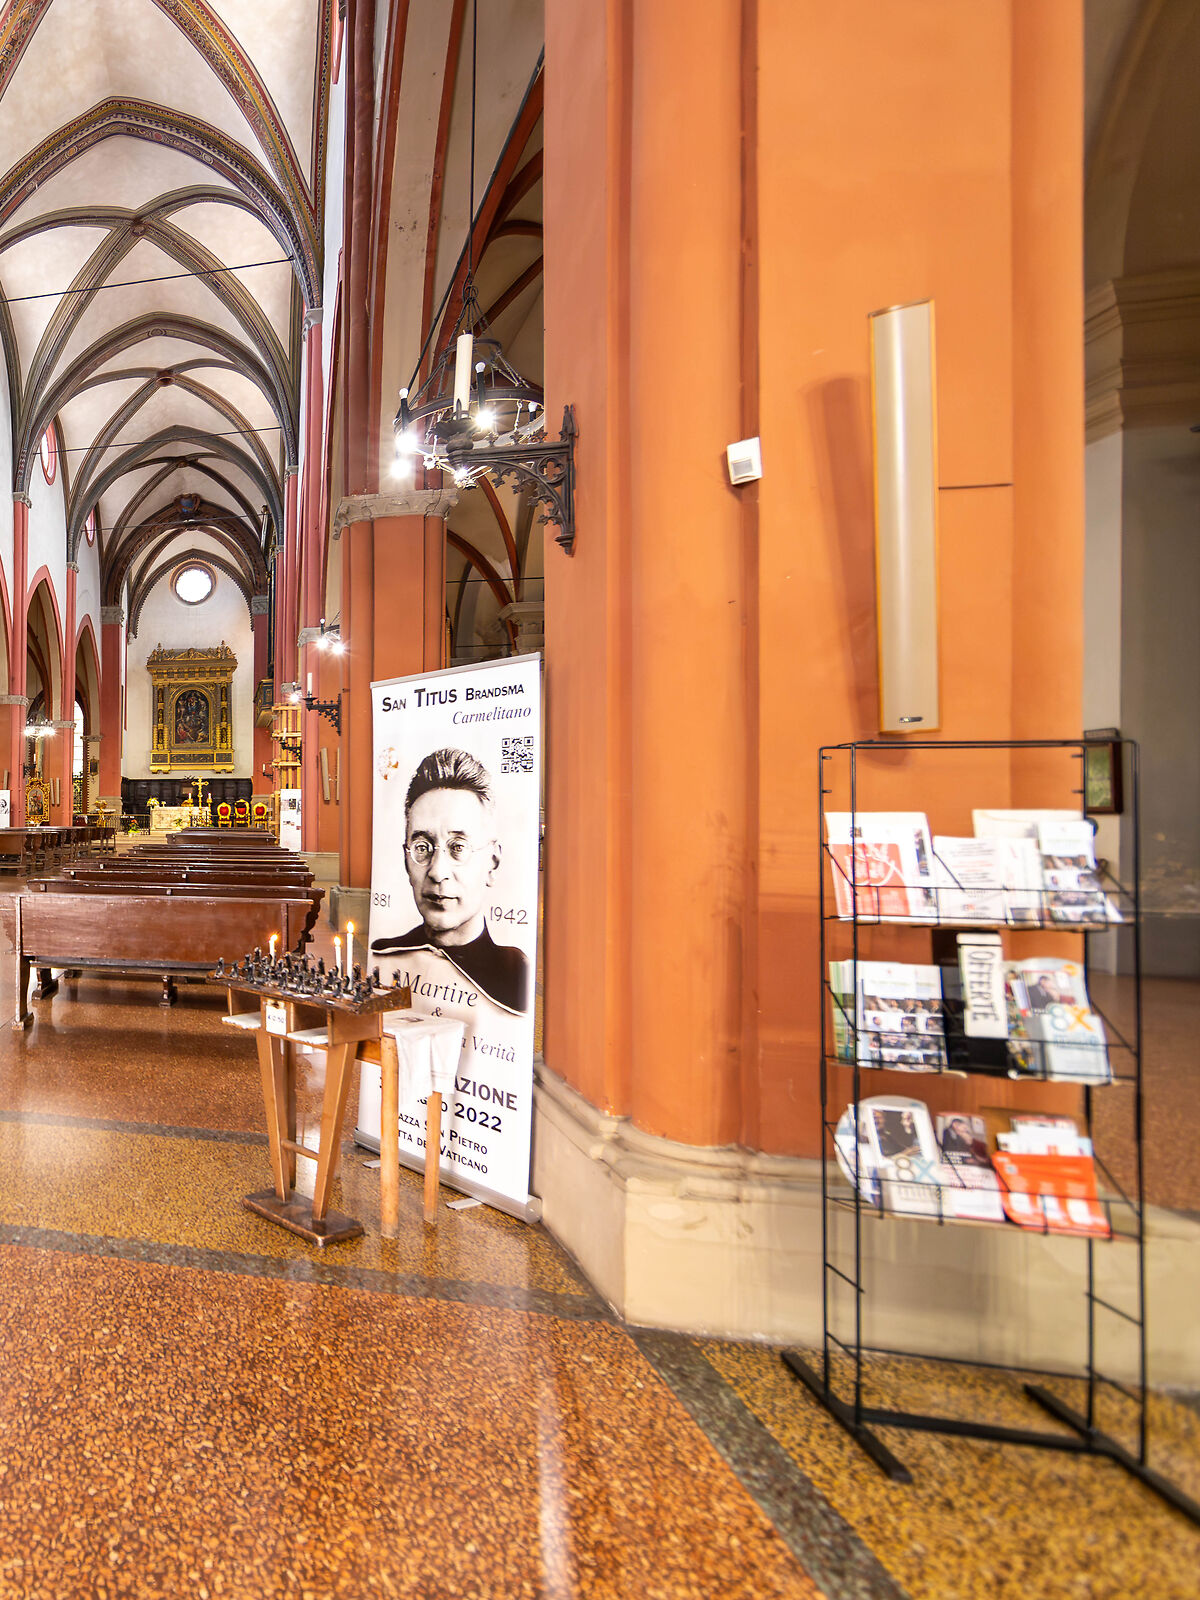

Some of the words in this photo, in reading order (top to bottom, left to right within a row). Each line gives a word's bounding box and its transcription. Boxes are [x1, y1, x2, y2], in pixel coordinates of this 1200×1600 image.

[452, 706, 532, 725] Carmelitano
[490, 906, 529, 925] 1942
[402, 971, 478, 1007] Martire
[968, 950, 999, 1022] OFFERTE
[472, 1036, 516, 1063] Verità
[454, 1102, 502, 1133] 2022
[450, 1129, 488, 1155] PIETRO
[439, 1145, 488, 1174] VATICANO
